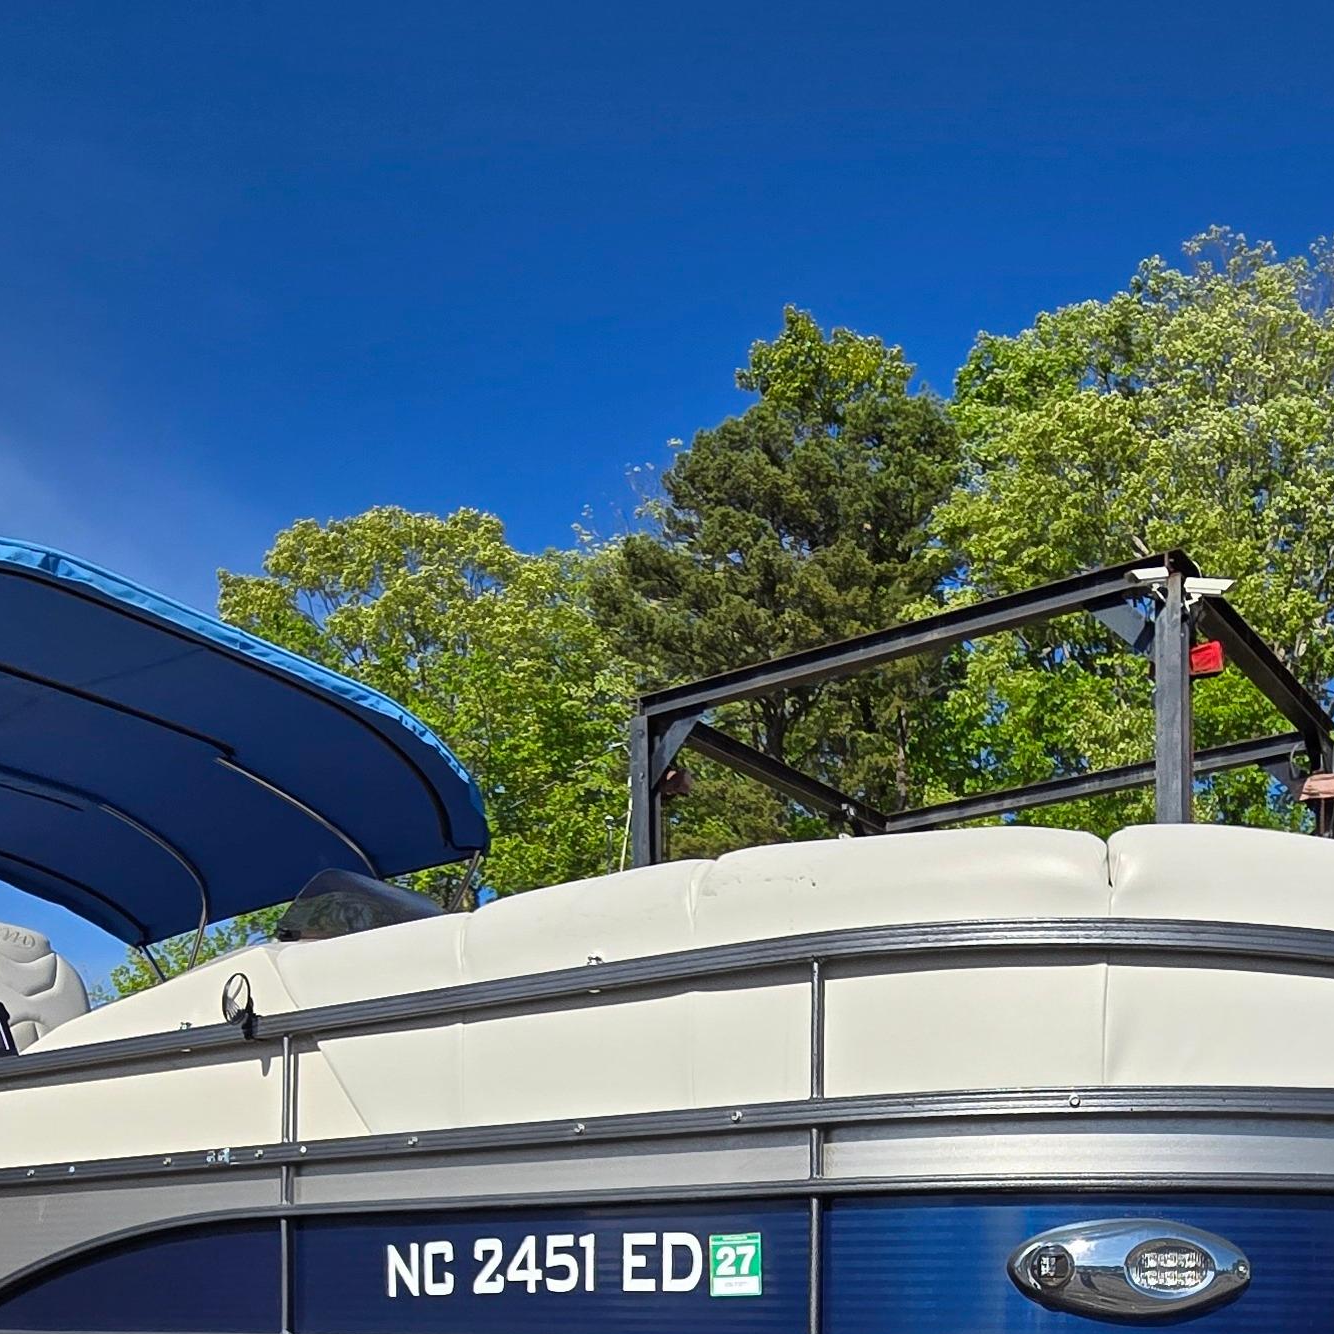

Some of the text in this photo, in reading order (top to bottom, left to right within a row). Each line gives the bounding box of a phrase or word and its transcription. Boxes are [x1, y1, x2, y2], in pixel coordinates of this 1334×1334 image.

[386, 1232, 704, 1298] NC 2451 ED
[715, 1244, 756, 1276] 27
